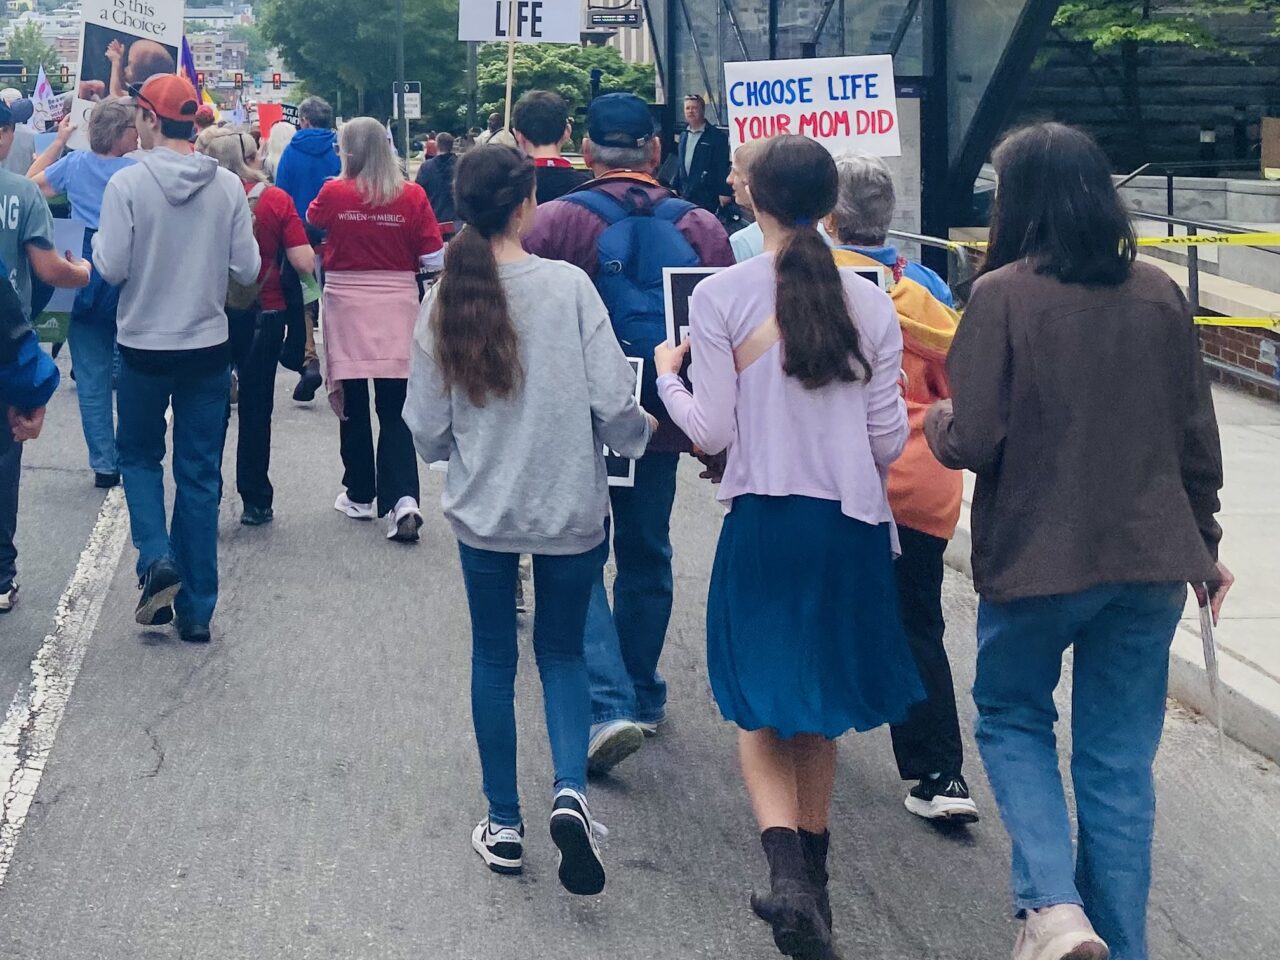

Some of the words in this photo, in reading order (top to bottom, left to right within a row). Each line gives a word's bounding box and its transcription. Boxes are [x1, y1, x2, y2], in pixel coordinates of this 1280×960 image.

[100, 8, 108, 21] a
[112, 9, 167, 36] Choice?
[729, 77, 813, 107] CHOOSE
[828, 73, 879, 101] LIFE
[734, 113, 791, 143] YOUR
[798, 110, 850, 138] MOM
[856, 109, 894, 135] DID
